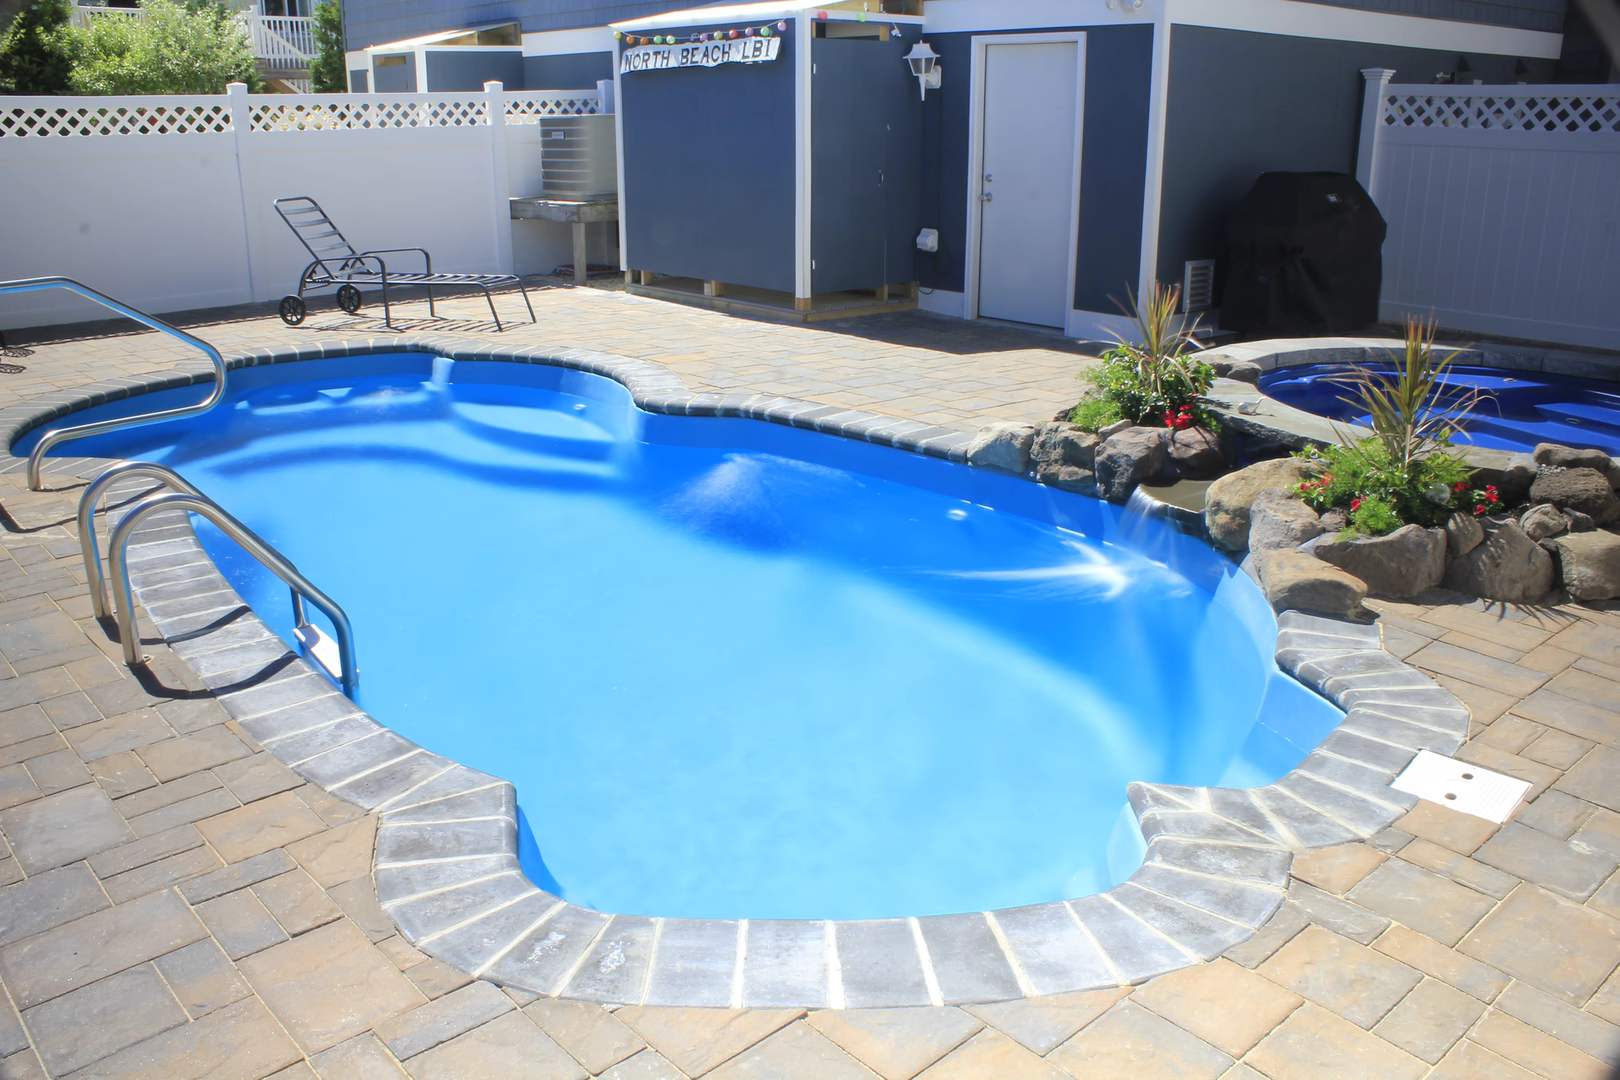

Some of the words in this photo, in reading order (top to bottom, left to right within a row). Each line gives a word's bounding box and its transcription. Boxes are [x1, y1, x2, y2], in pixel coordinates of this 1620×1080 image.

[624, 50, 670, 71] NORTH
[680, 43, 731, 65] BEACH
[741, 38, 771, 60] LBI
